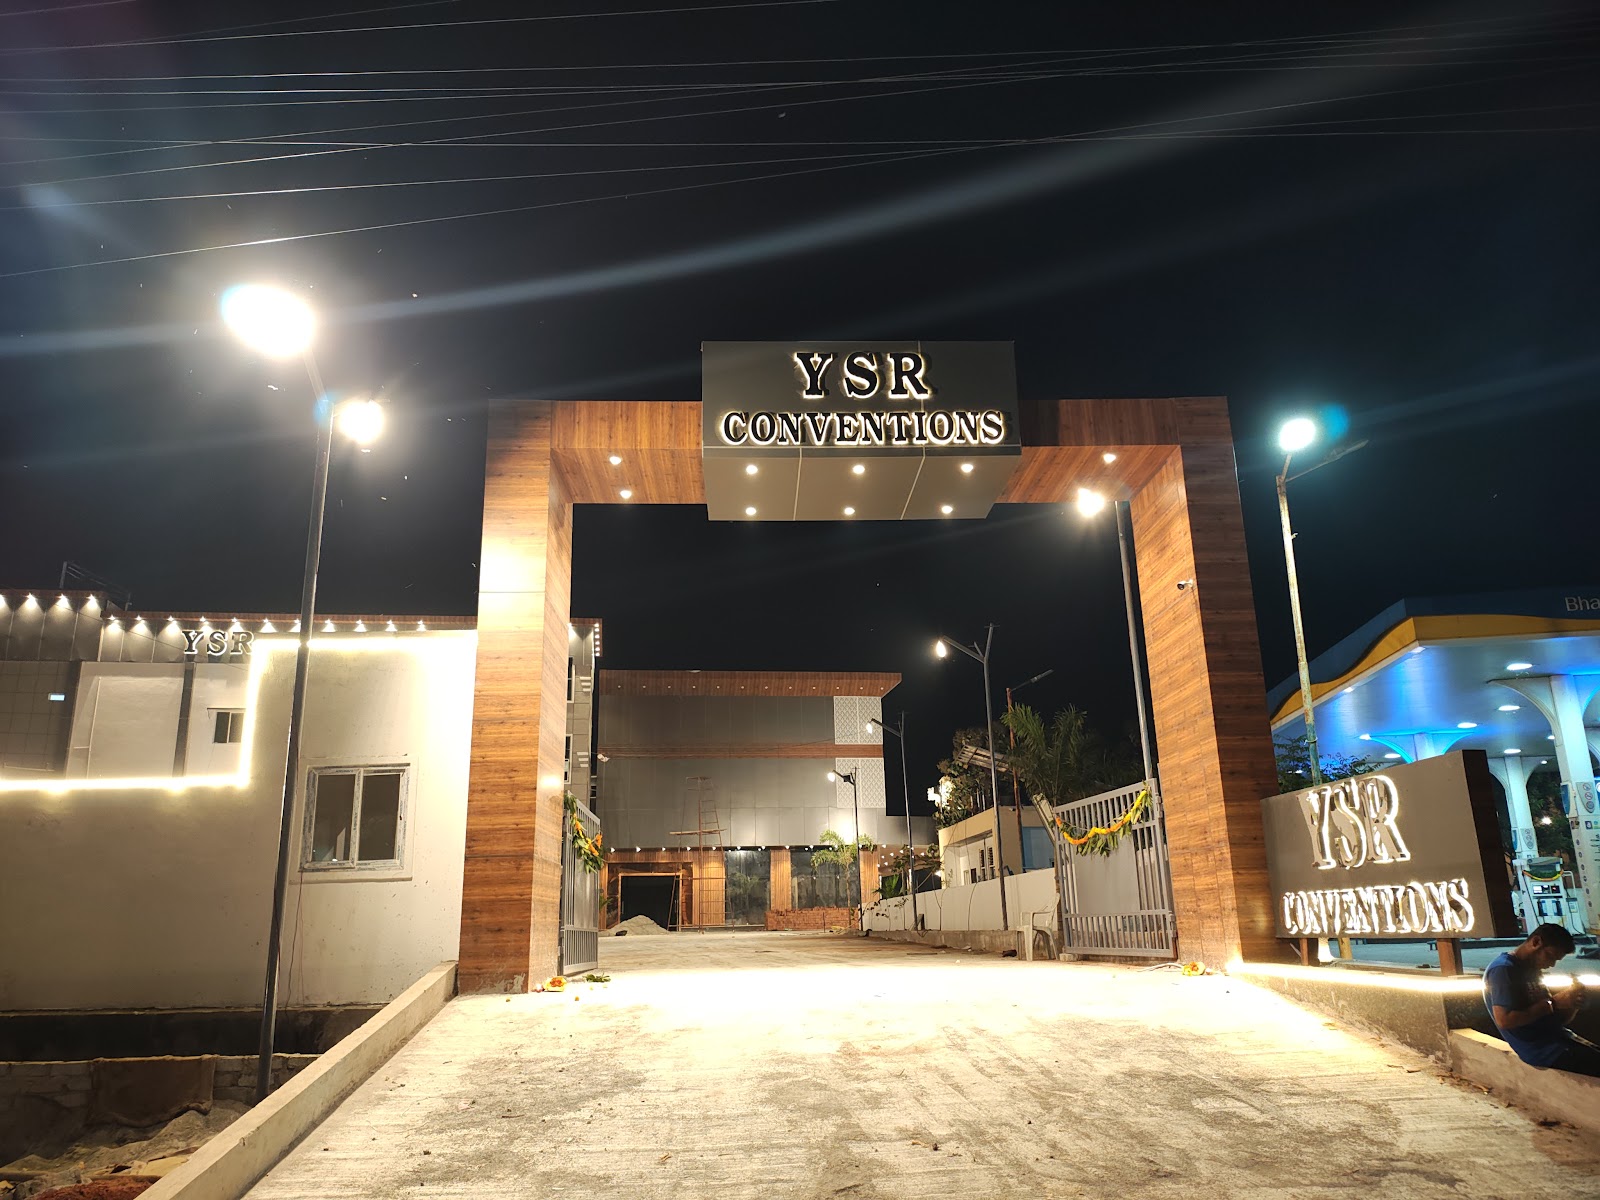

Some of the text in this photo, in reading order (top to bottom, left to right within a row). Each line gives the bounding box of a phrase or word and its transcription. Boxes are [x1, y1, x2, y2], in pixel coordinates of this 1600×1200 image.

[793, 351, 931, 399] YSR
[719, 409, 1006, 446] CONVENTIONS
[181, 629, 255, 656] YSR
[1297, 774, 1411, 870] YSR
[1280, 877, 1474, 935] CONVENTIONS
